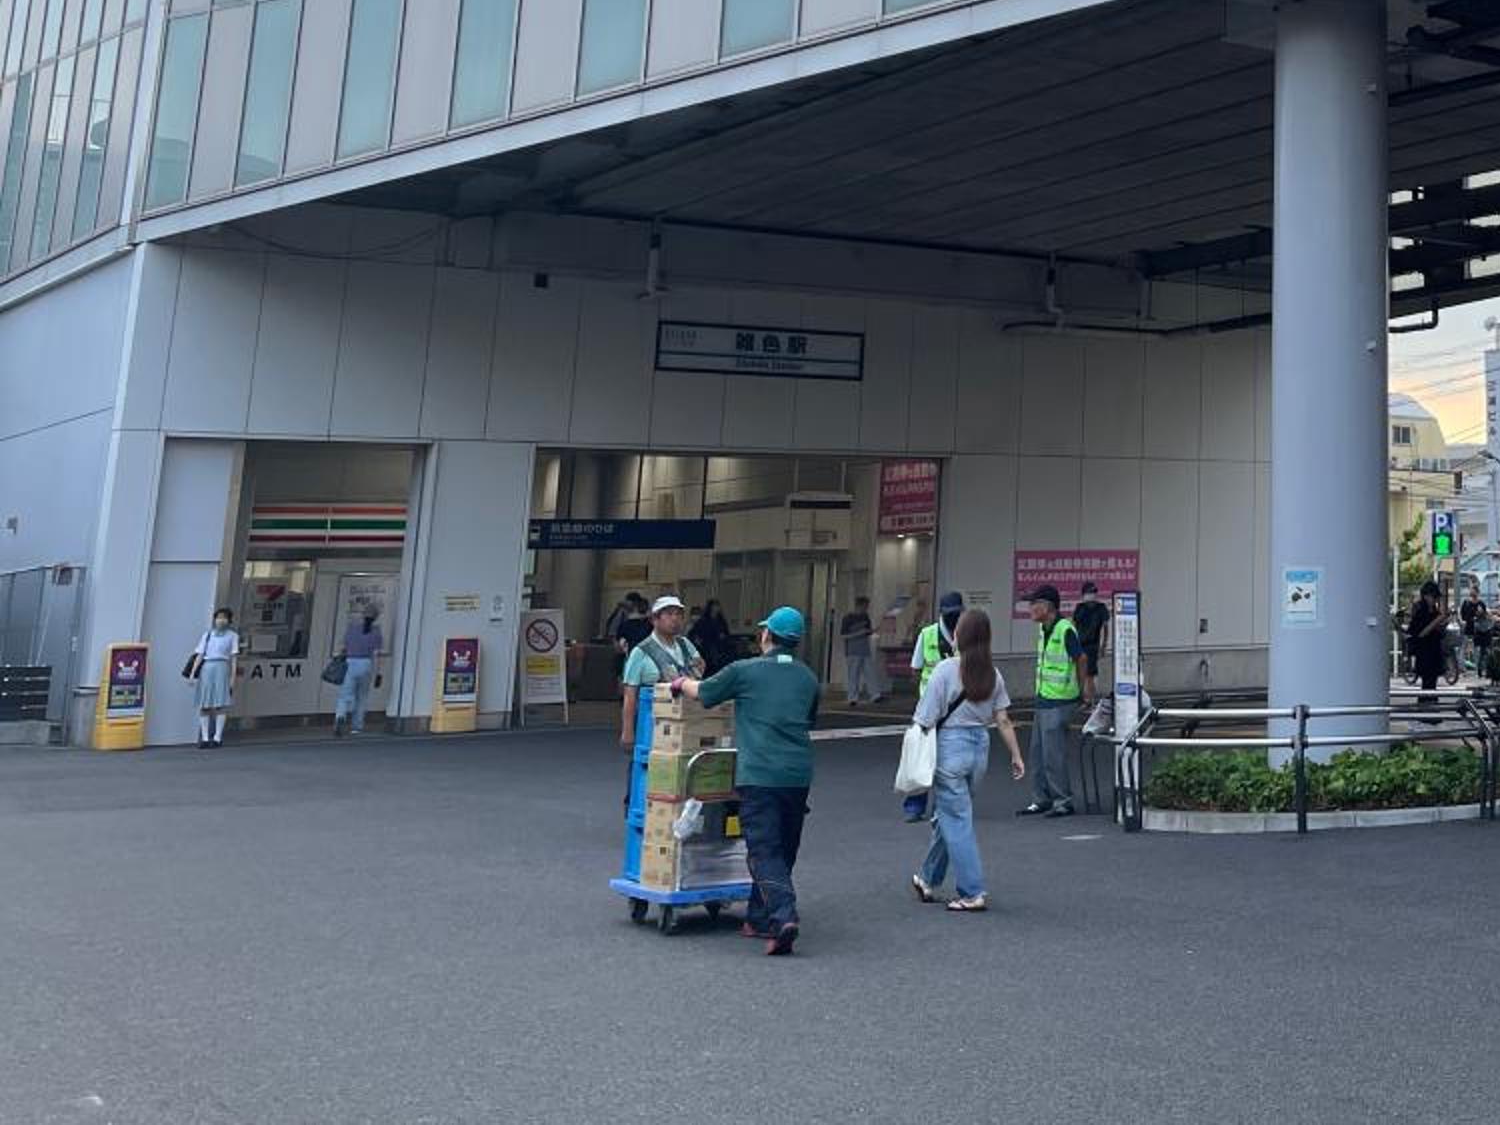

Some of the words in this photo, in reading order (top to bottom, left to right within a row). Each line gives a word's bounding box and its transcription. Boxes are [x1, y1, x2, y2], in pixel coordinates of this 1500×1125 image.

[735, 332, 808, 355] 雑色駅
[1436, 513, 1448, 533] P
[251, 663, 302, 679] ATM
